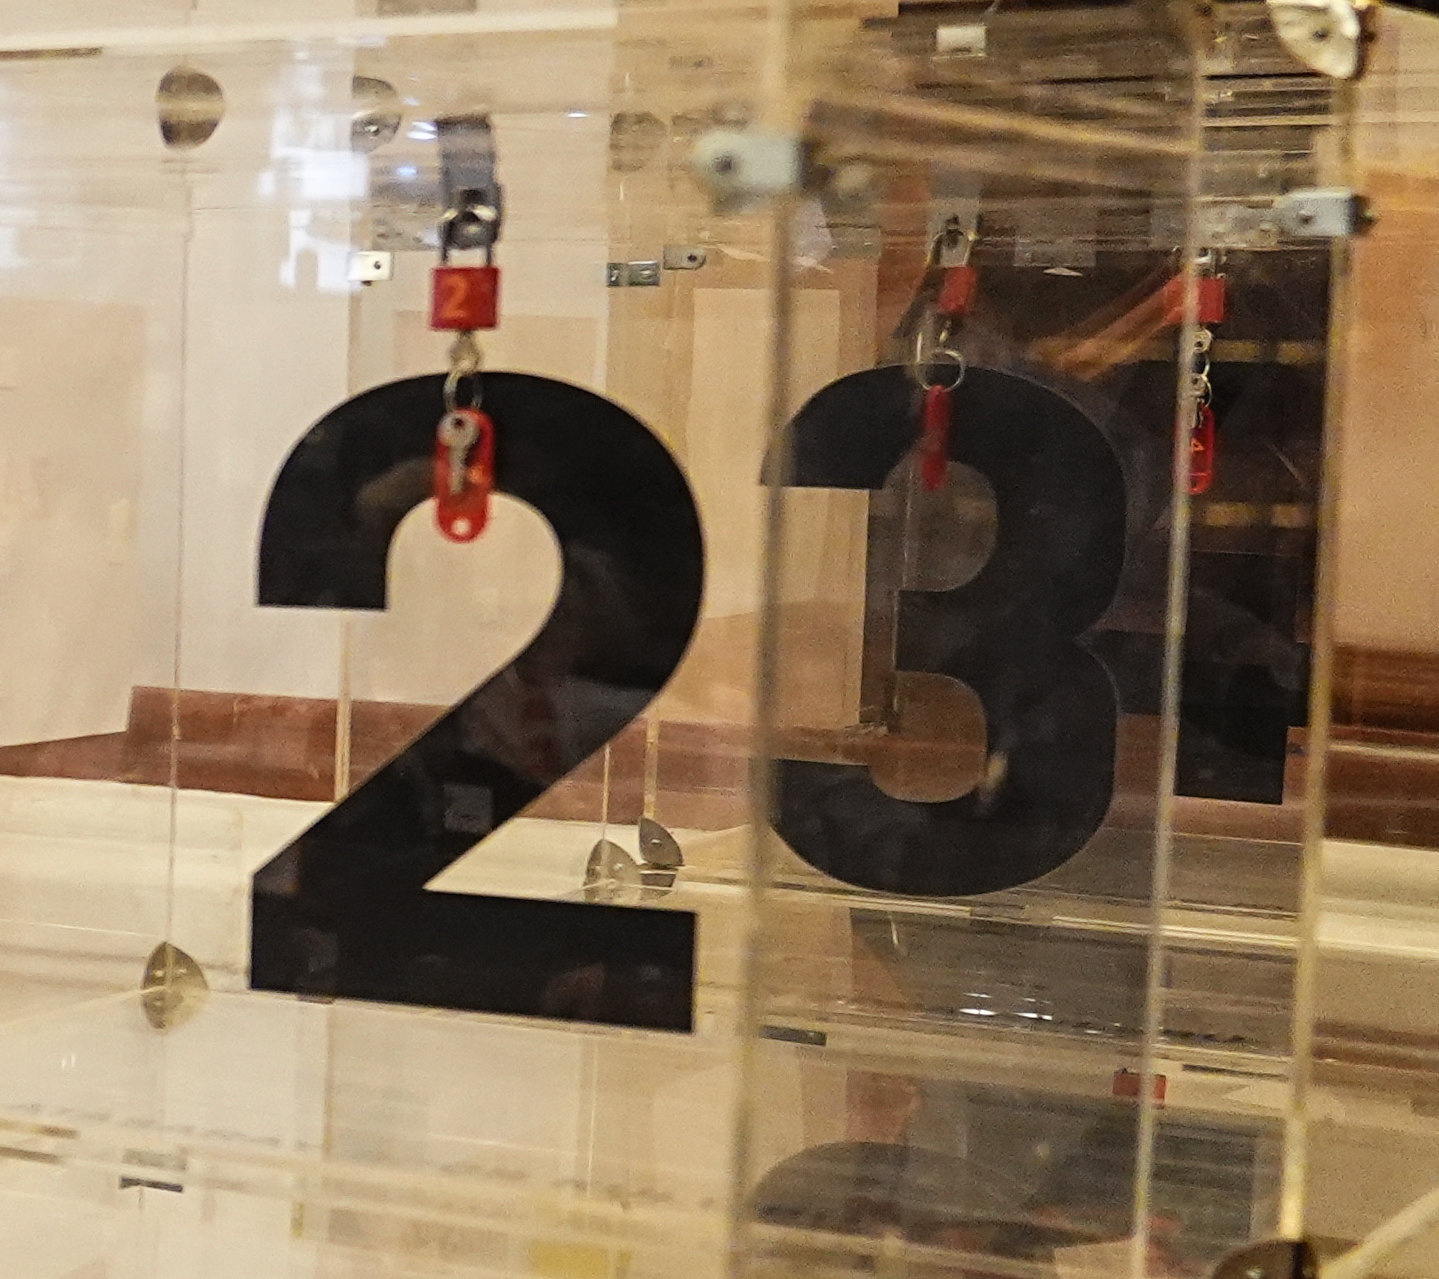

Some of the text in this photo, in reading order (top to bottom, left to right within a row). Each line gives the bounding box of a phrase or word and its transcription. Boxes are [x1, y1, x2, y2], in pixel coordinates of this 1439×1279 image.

[441, 273, 468, 319] 2
[248, 370, 705, 1035] 2
[757, 359, 1129, 897] 3
